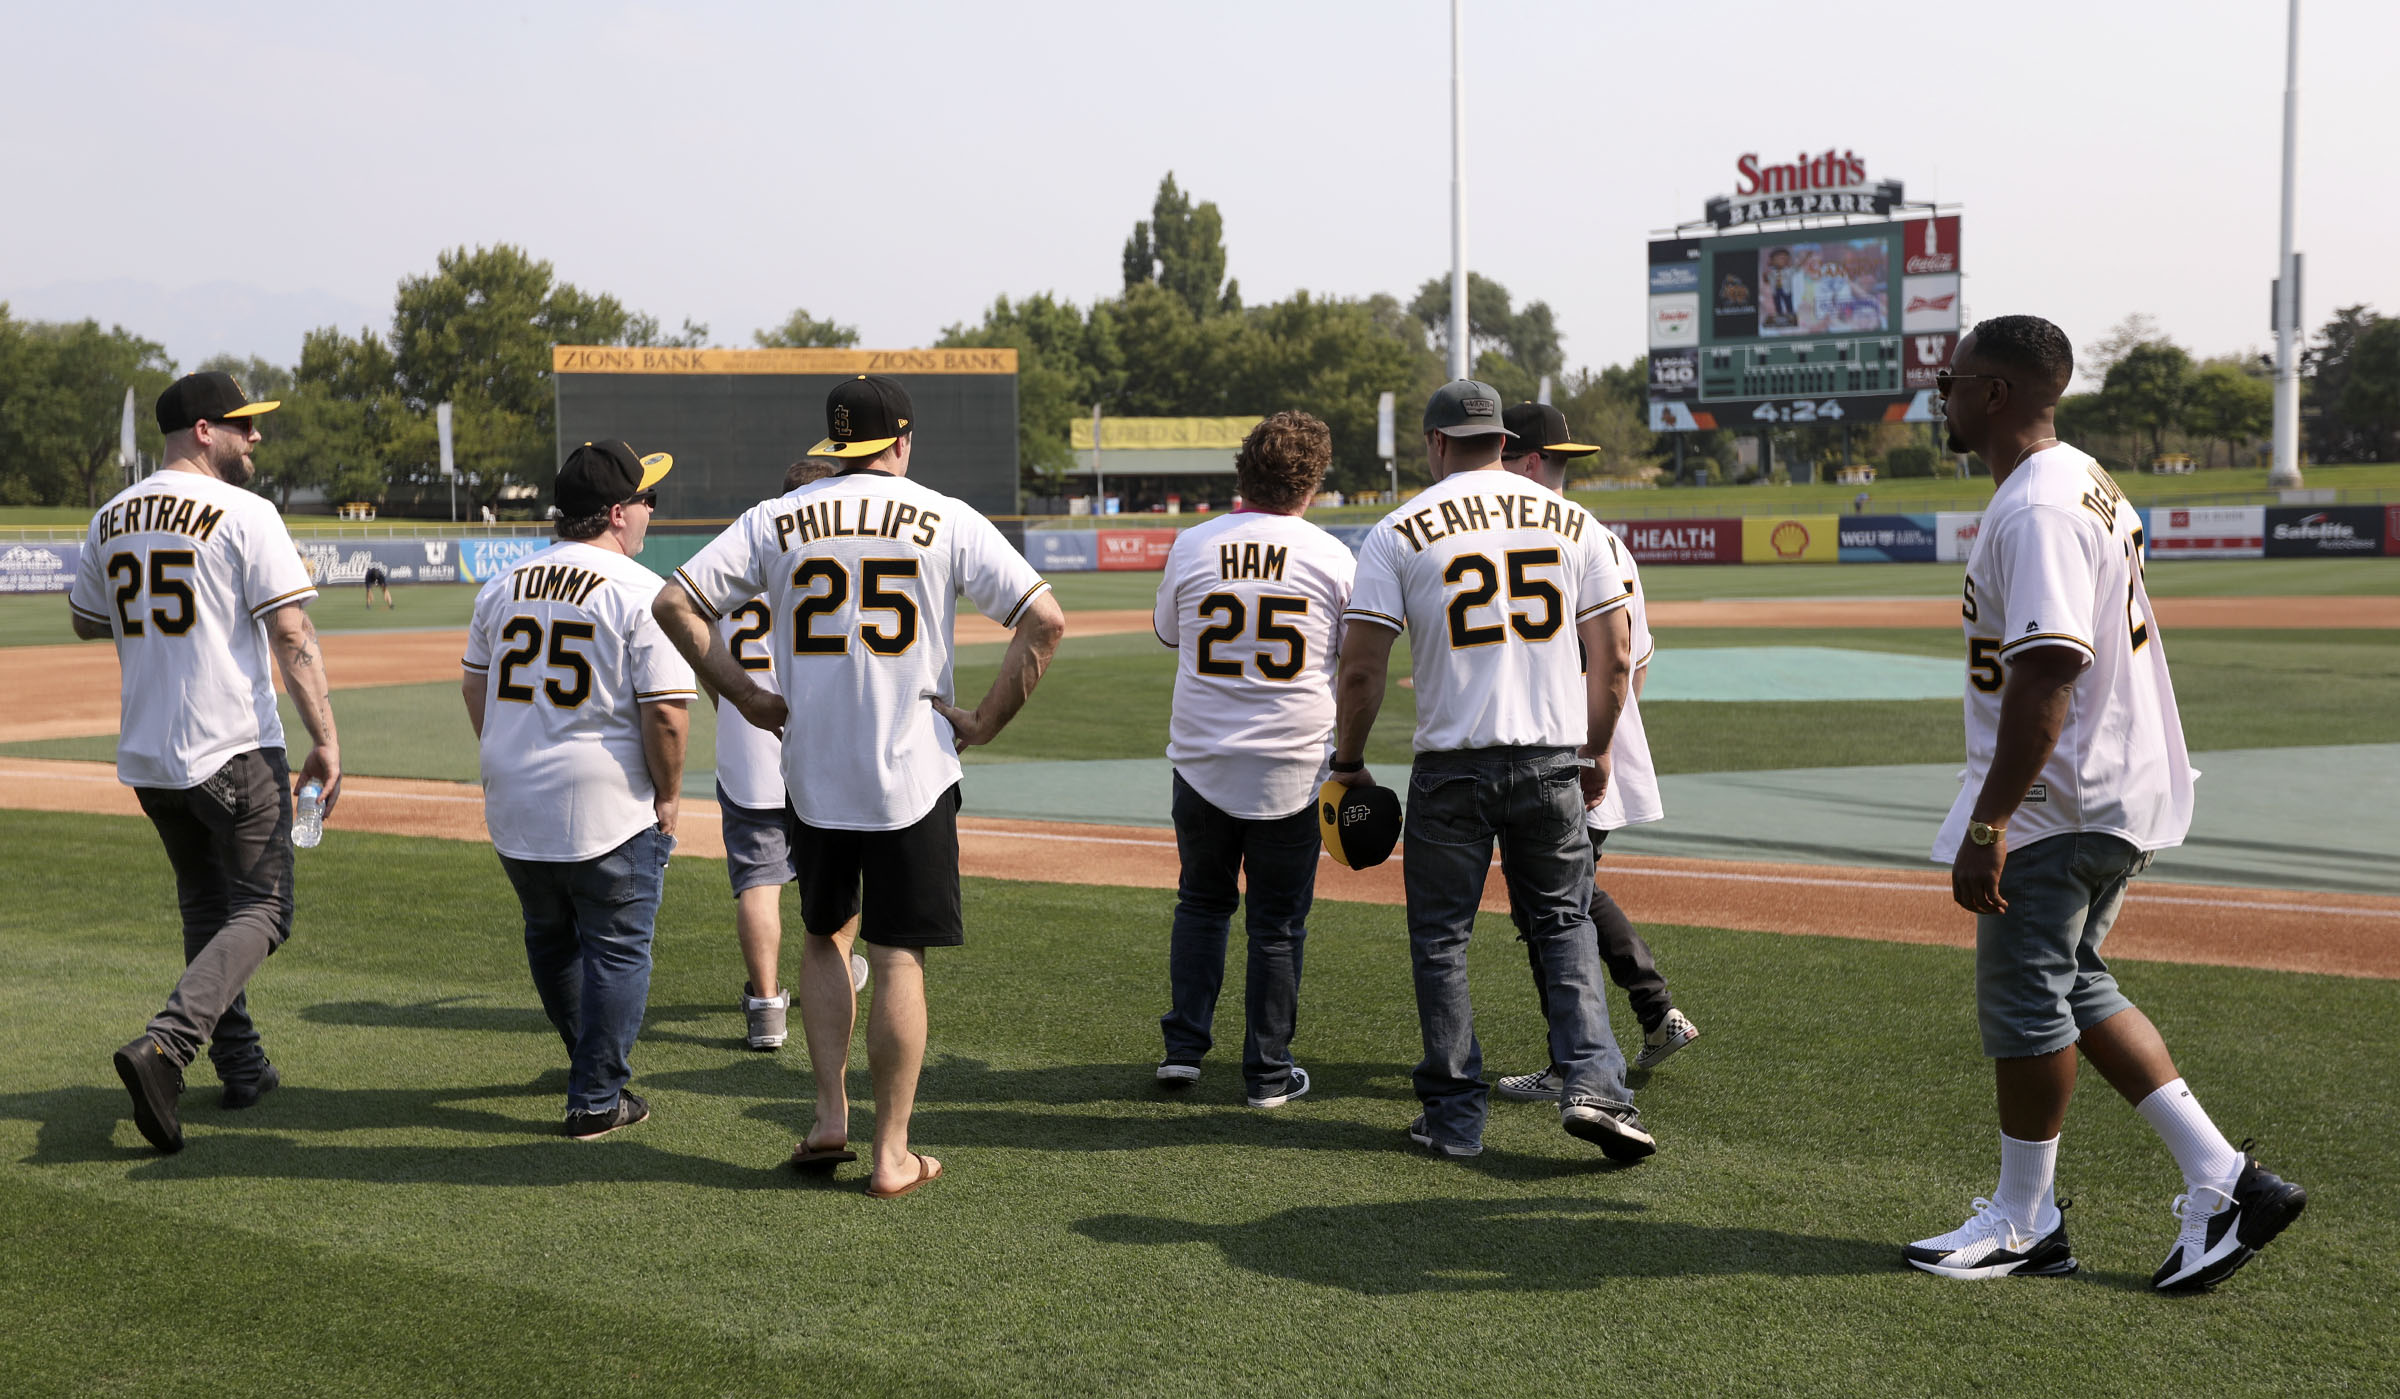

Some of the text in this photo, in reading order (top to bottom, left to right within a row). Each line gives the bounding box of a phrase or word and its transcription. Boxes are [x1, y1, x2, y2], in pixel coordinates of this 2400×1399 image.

[1736, 148, 1866, 197] Smith's
[1729, 193, 1876, 225] BALLPARK
[563, 351, 634, 370] ZIONS
[643, 351, 707, 370] BANK
[868, 352, 936, 370] ZIONS
[944, 352, 1005, 370] BANK
[1655, 367, 1694, 383] 140
[1752, 400, 1845, 423] 4:24
[99, 495, 224, 546] BERTRAM
[774, 498, 941, 553] PHILLIPS
[1392, 495, 1585, 553] YEAH-YEAH
[1841, 530, 1876, 546] WGU
[2273, 522, 2354, 539] Safelite
[475, 541, 534, 557] ZIONS
[1105, 537, 1144, 553] WCF
[1632, 528, 1716, 549] HEALTH
[419, 565, 455, 577] HEALTH
[1220, 542, 1288, 581] HAM
[107, 550, 196, 638] 25
[514, 565, 607, 606] TOMMY
[1443, 547, 1564, 650] 25
[791, 557, 919, 656] 25
[1197, 592, 1309, 681] 25
[497, 616, 596, 710] 25
